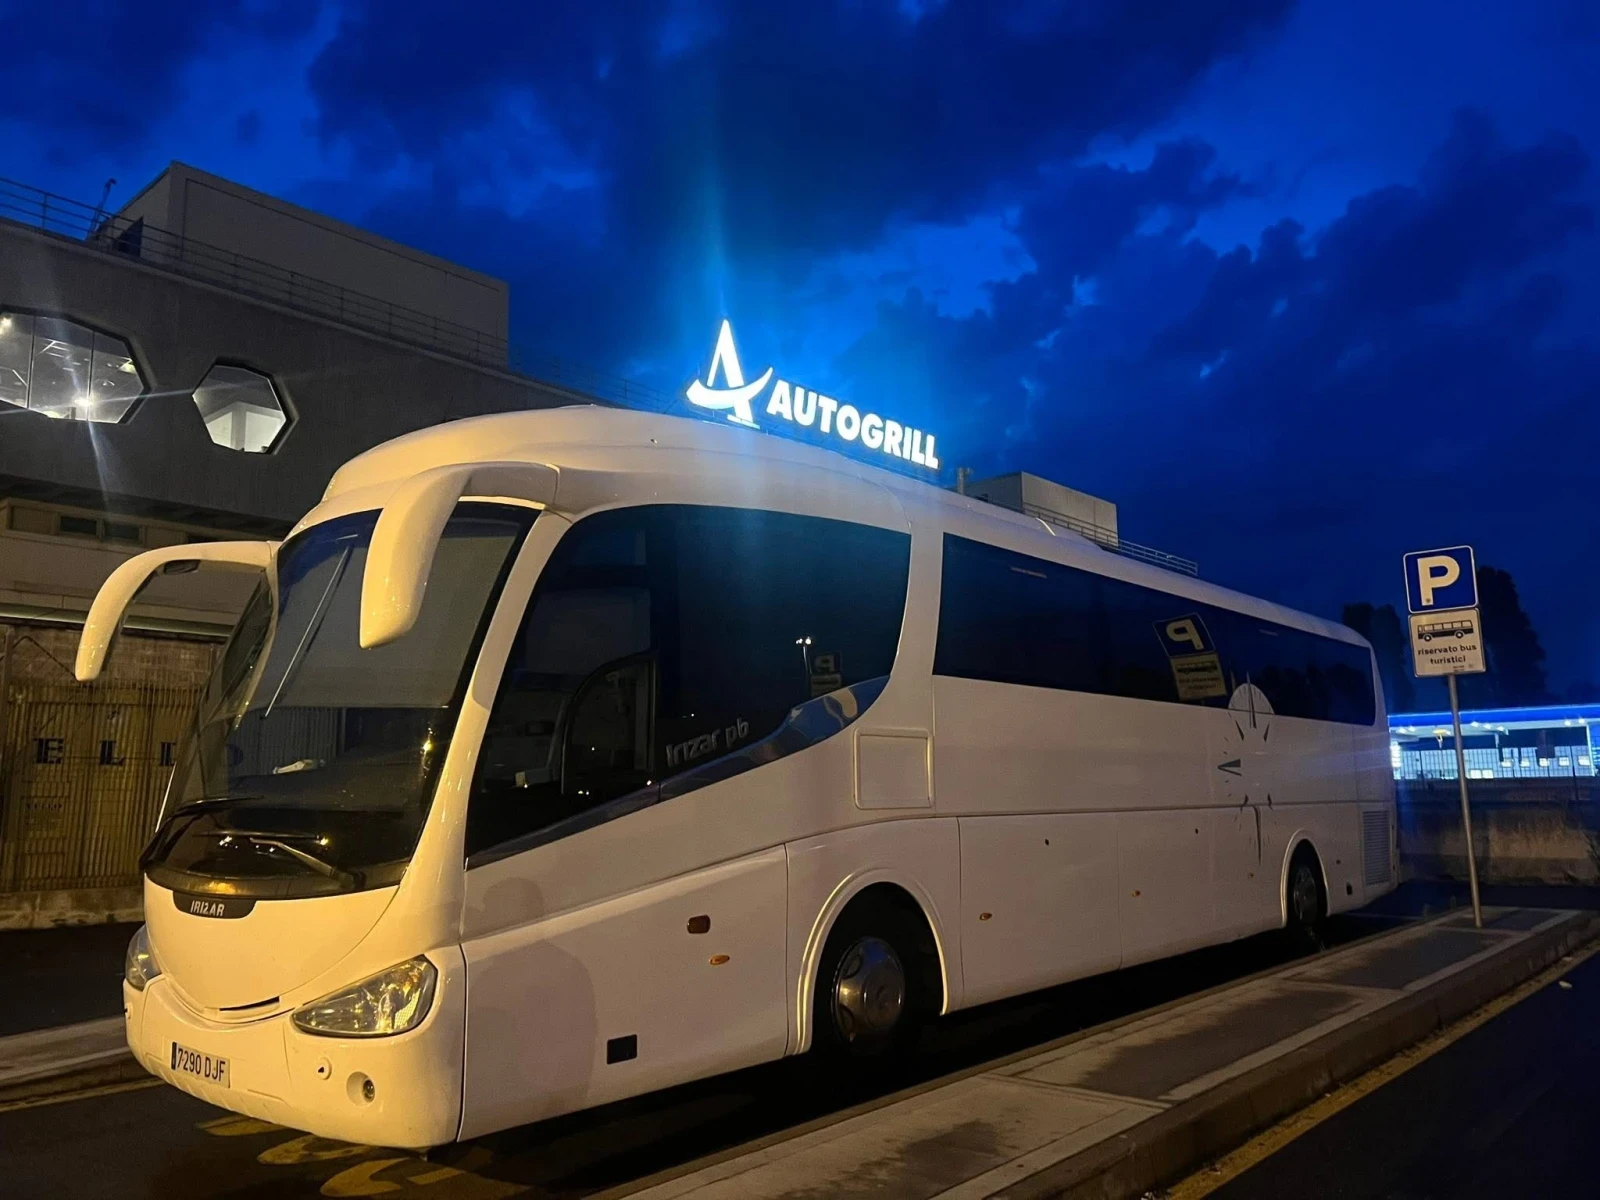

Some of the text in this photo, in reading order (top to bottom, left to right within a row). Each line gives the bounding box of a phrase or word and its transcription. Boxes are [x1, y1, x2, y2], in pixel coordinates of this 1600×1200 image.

[766, 379, 939, 469] AUTOGRILL
[1417, 555, 1460, 606] P
[1417, 643, 1477, 656] riservato bus
[1429, 655, 1466, 665] turistici
[725, 716, 749, 749] pb
[190, 900, 225, 917] IRIZAR
[177, 1048, 226, 1082] 7290 DJF
